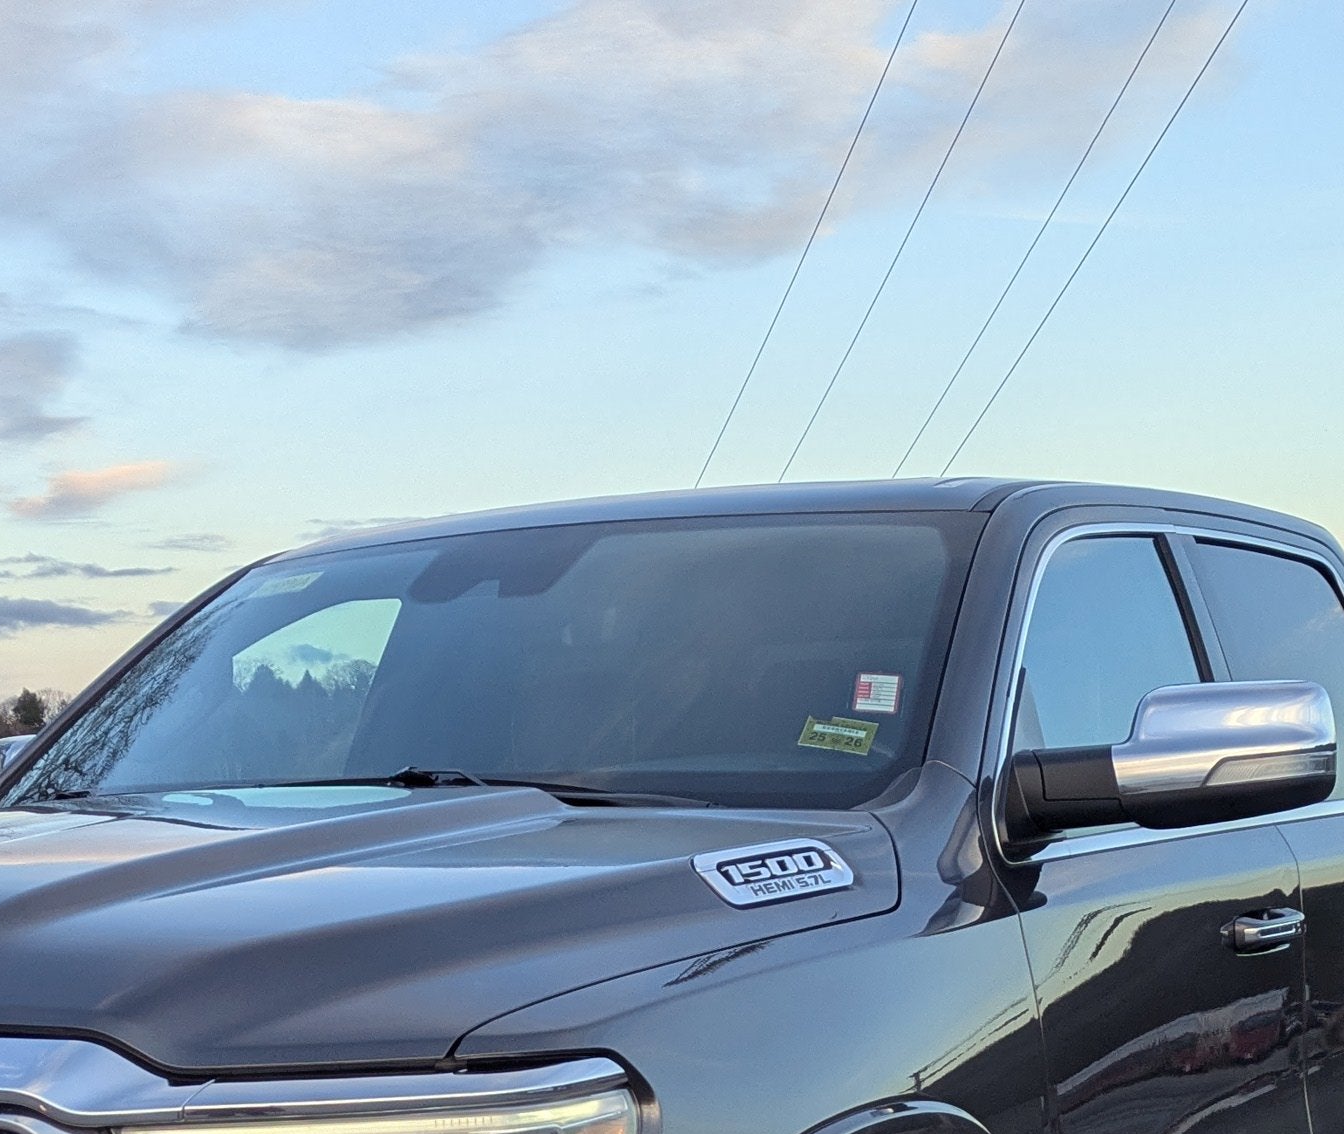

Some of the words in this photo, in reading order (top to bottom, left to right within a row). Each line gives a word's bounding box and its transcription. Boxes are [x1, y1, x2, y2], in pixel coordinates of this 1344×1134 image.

[808, 731, 827, 742] 25
[844, 736, 864, 748] 26
[720, 851, 825, 884] 1500
[751, 880, 795, 897] HEMI
[797, 874, 832, 889] 5.7L
